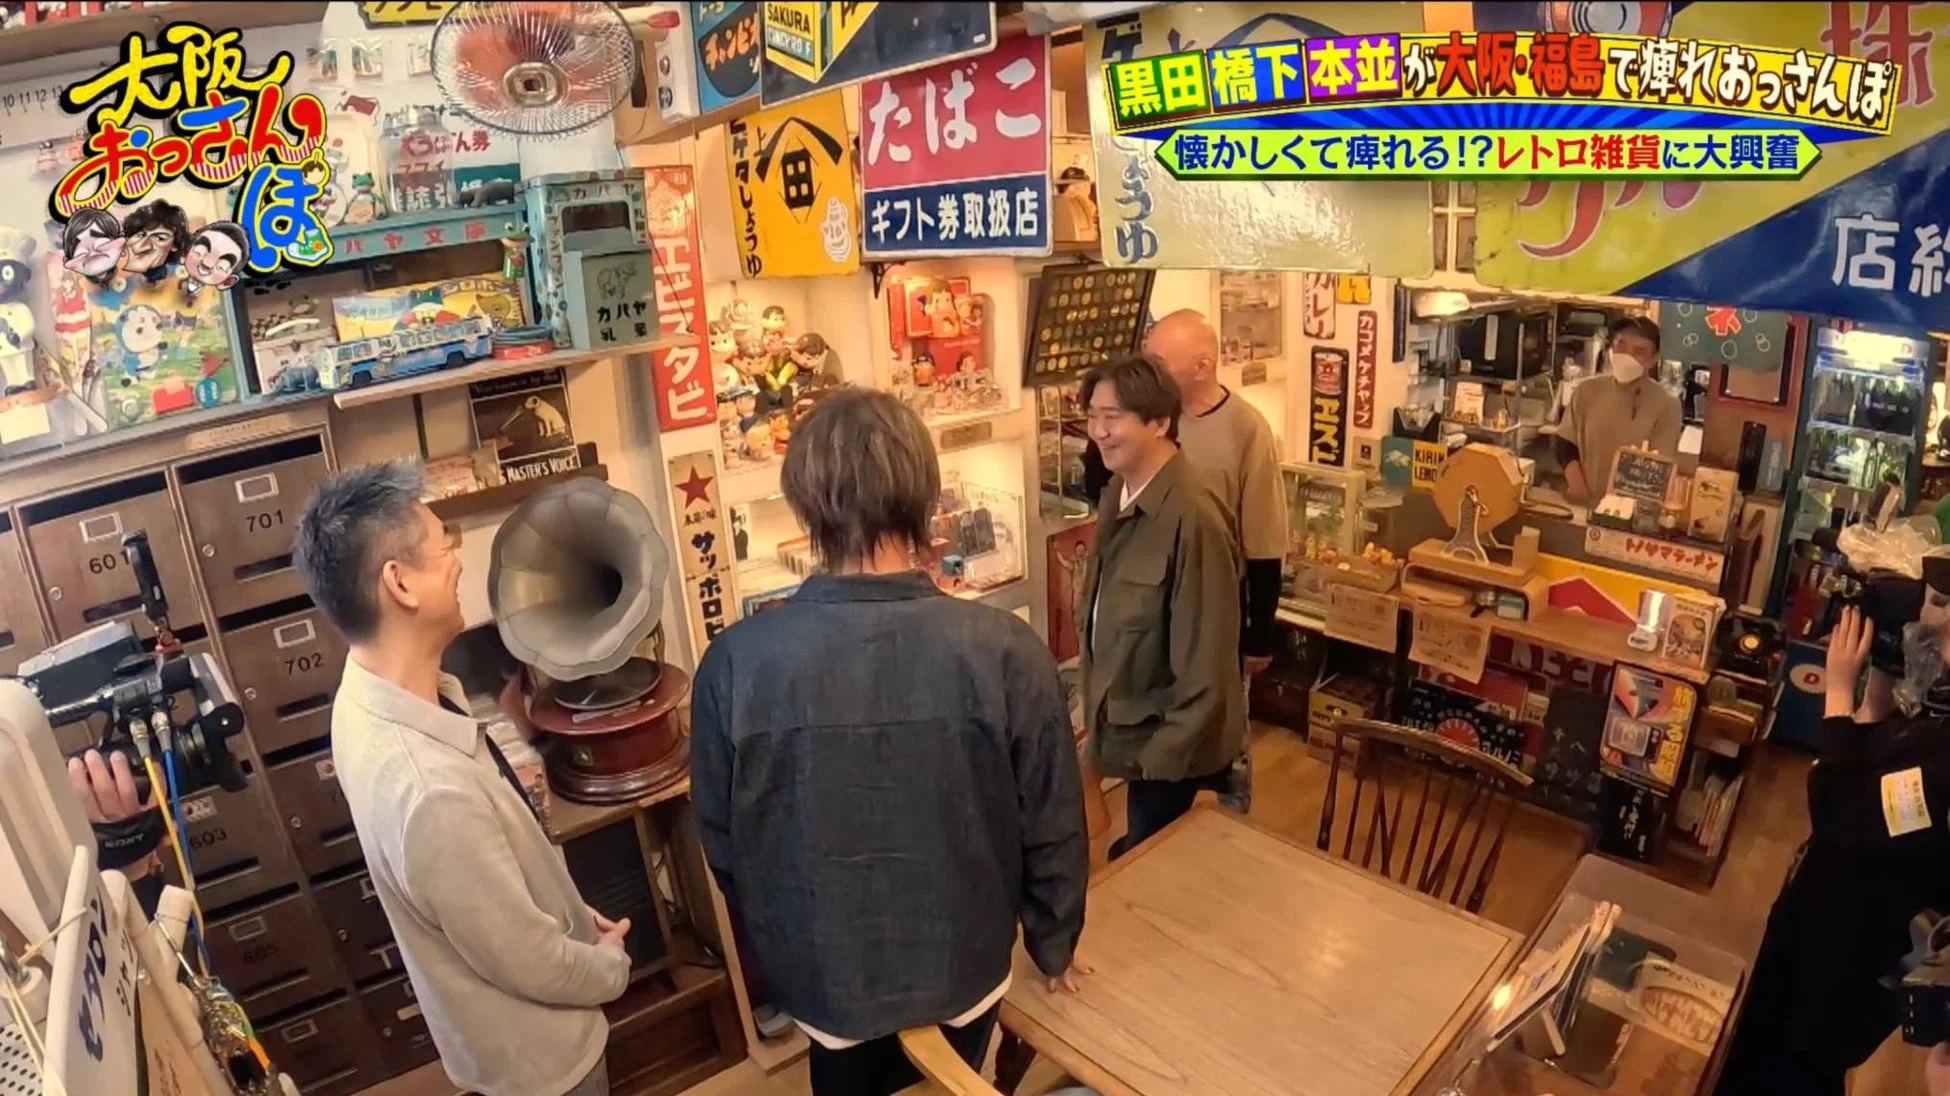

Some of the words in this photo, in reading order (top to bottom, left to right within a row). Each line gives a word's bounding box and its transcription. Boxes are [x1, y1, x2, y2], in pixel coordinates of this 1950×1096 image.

[767, 3, 811, 35] SAKURA
[36, 88, 47, 101] 12
[865, 57, 1042, 166] たばこ
[870, 188, 1040, 246] ギフト券取扱店
[653, 237, 708, 420] エビスタビ
[1415, 448, 1445, 464] KIRIN
[507, 461, 549, 484] MASTER'S
[246, 509, 285, 533] 701
[285, 652, 324, 675] 702
[104, 832, 144, 849] SONY
